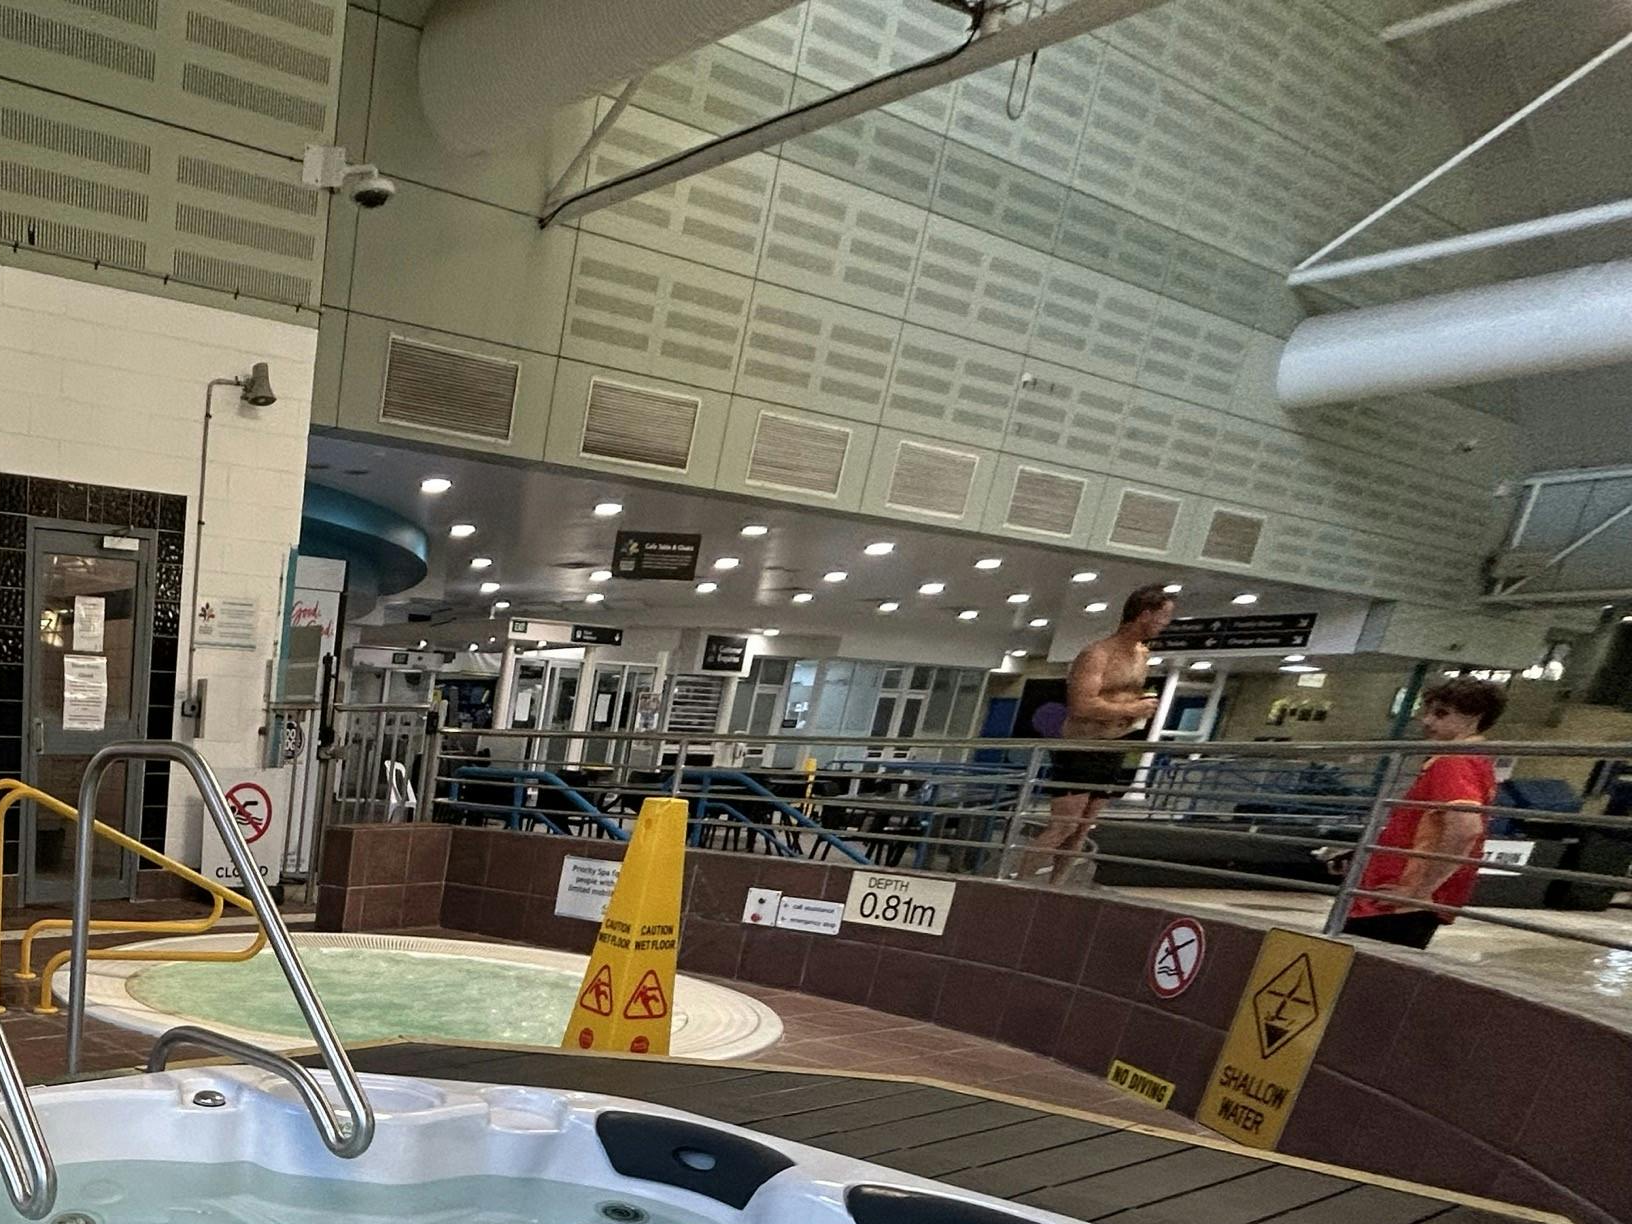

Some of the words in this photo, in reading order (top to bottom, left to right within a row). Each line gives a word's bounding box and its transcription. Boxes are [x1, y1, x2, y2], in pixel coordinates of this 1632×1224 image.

[572, 865, 596, 876] Priority
[597, 867, 610, 877] Spa
[576, 877, 598, 885] people
[868, 877, 910, 892] DEPTH
[860, 892, 935, 927] 0.81m
[605, 919, 630, 934] CAUTION
[641, 925, 673, 936] CAUTION
[635, 941, 650, 951] WET
[651, 939, 676, 950] FLOOR
[1111, 1065, 1129, 1086] NO
[1128, 1072, 1168, 1103] DIVING
[1220, 1065, 1289, 1111] SHALLOW
[1219, 1096, 1264, 1135] WATER
